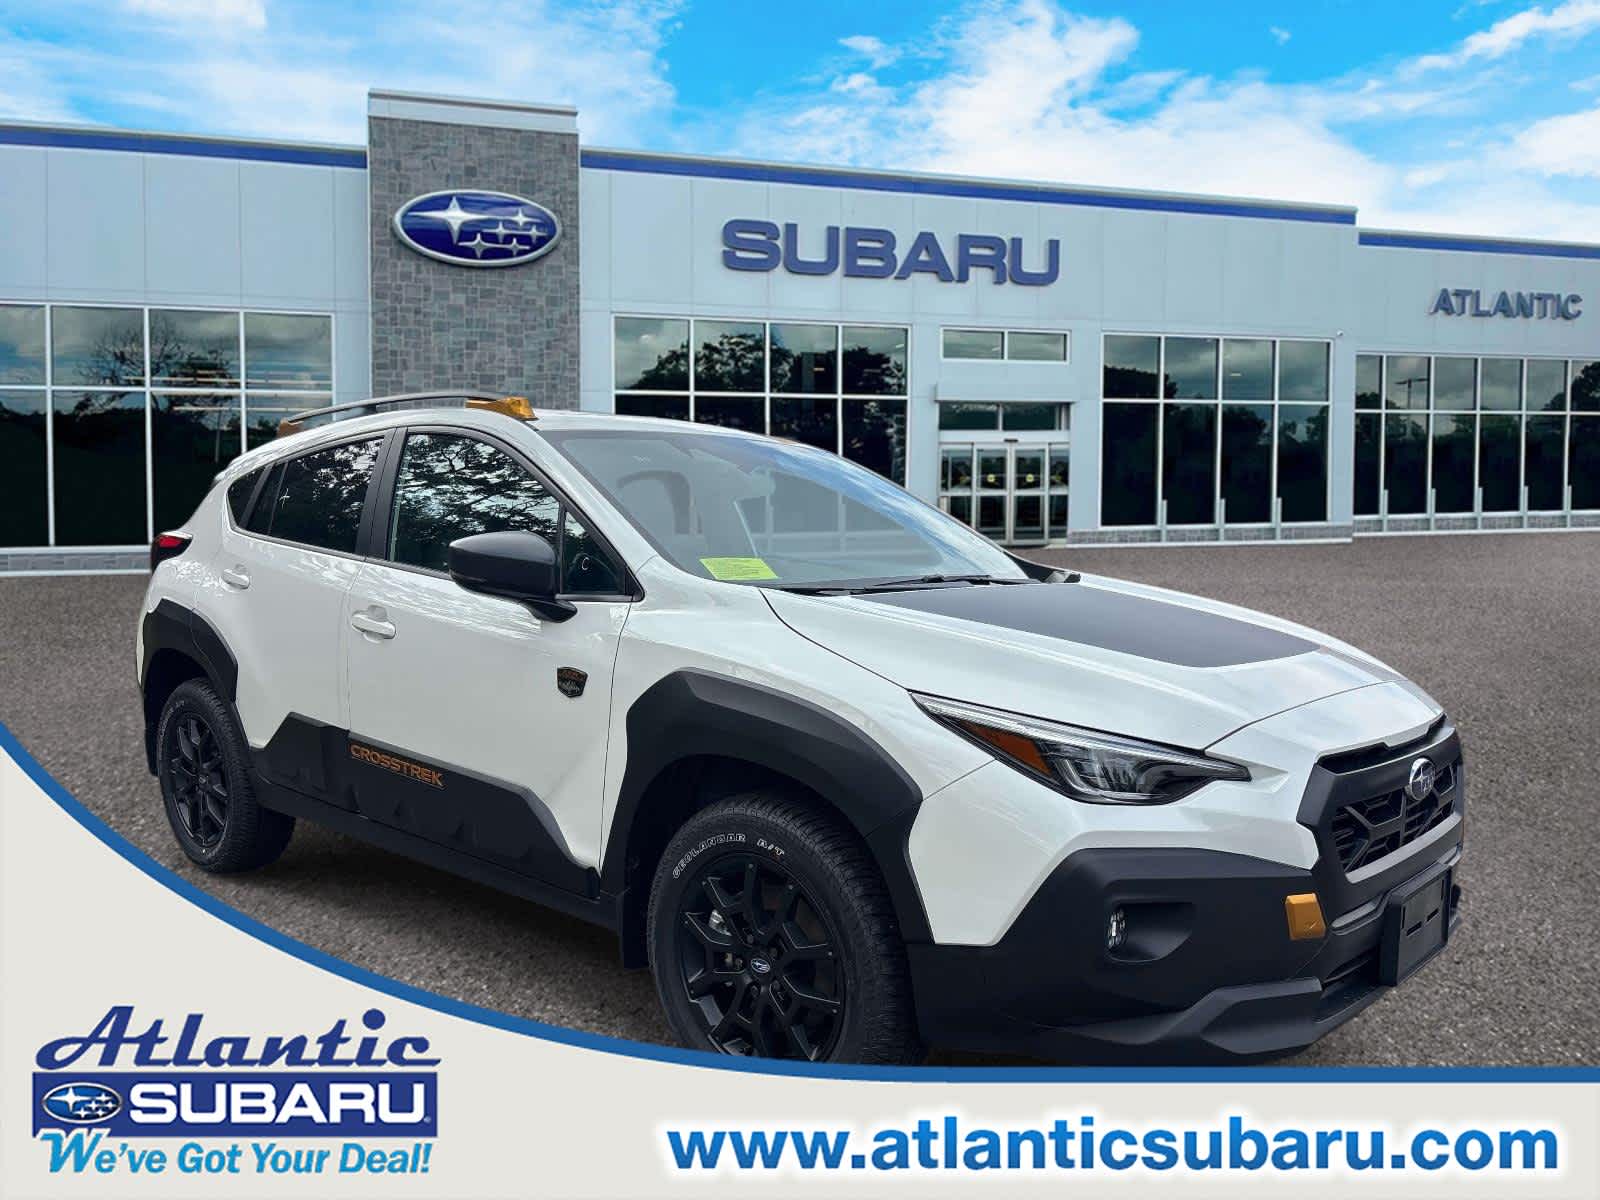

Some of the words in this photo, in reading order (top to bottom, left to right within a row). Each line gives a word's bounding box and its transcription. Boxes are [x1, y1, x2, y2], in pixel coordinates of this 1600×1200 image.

[722, 218, 1061, 287] SUBARU
[1431, 287, 1583, 321] ATLANTIC
[350, 743, 443, 786] CROSSTREK
[672, 833, 746, 879] GEOLANDAR
[756, 838, 785, 856] A/T
